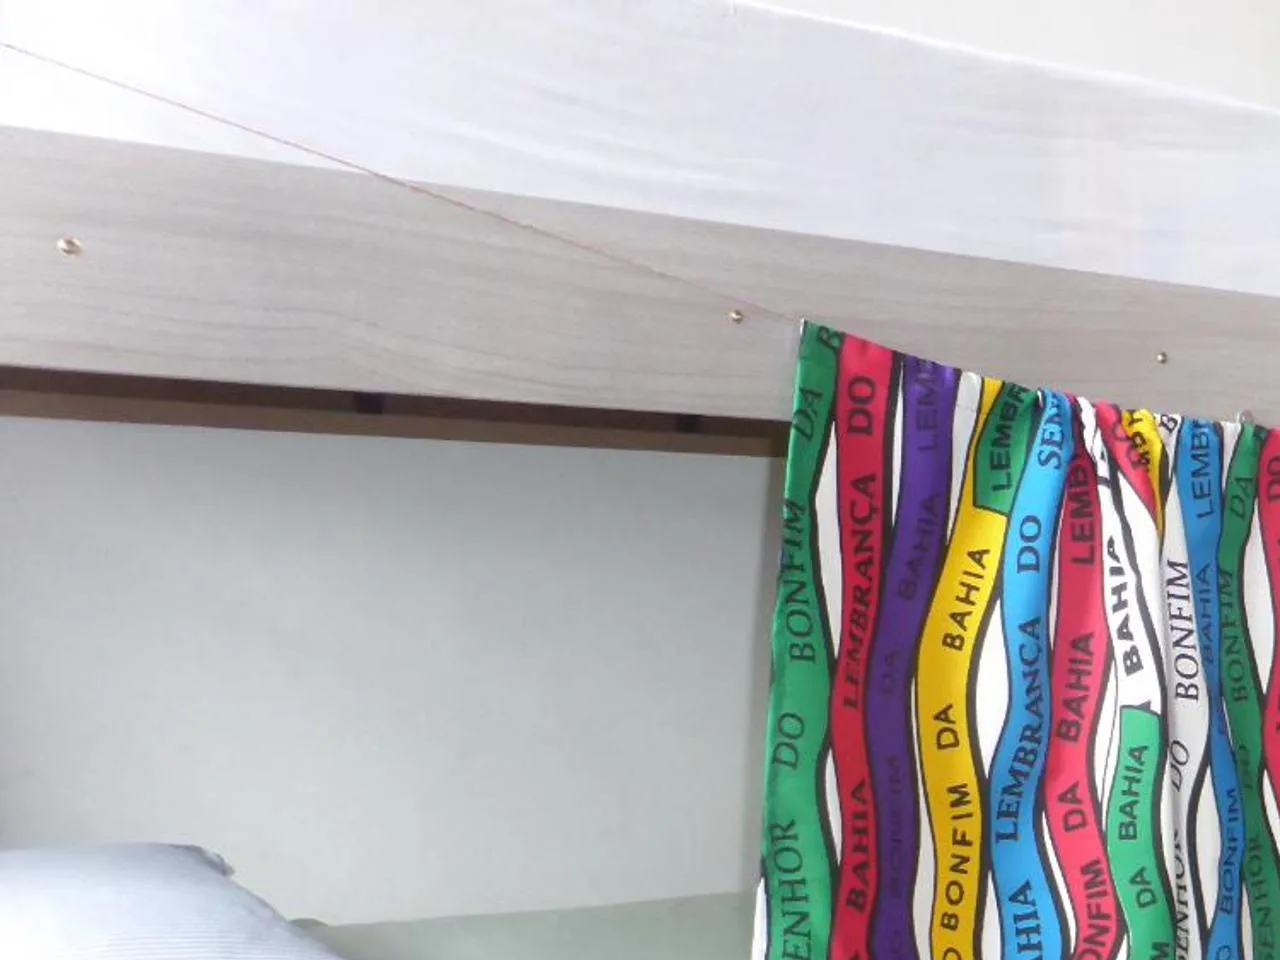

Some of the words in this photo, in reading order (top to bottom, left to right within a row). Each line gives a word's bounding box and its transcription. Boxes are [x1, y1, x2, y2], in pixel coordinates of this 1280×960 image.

[848, 376, 877, 436] DO
[843, 473, 877, 710] LEMBRANÇA
[1016, 516, 1041, 575] DO
[942, 549, 992, 652] BAHIA
[1100, 535, 1143, 676] BAHIA
[1166, 558, 1198, 702] BONFIM
[936, 704, 963, 750] DA
[995, 616, 1041, 844] LEMBRANÇA
[1056, 632, 1094, 744] BAHIA
[773, 712, 806, 770] DO
[1058, 780, 1088, 832] DA
[1118, 744, 1147, 842] BAHIA
[847, 780, 873, 913] BAHIA
[941, 783, 974, 931] BONFIM
[1131, 867, 1158, 910] DA
